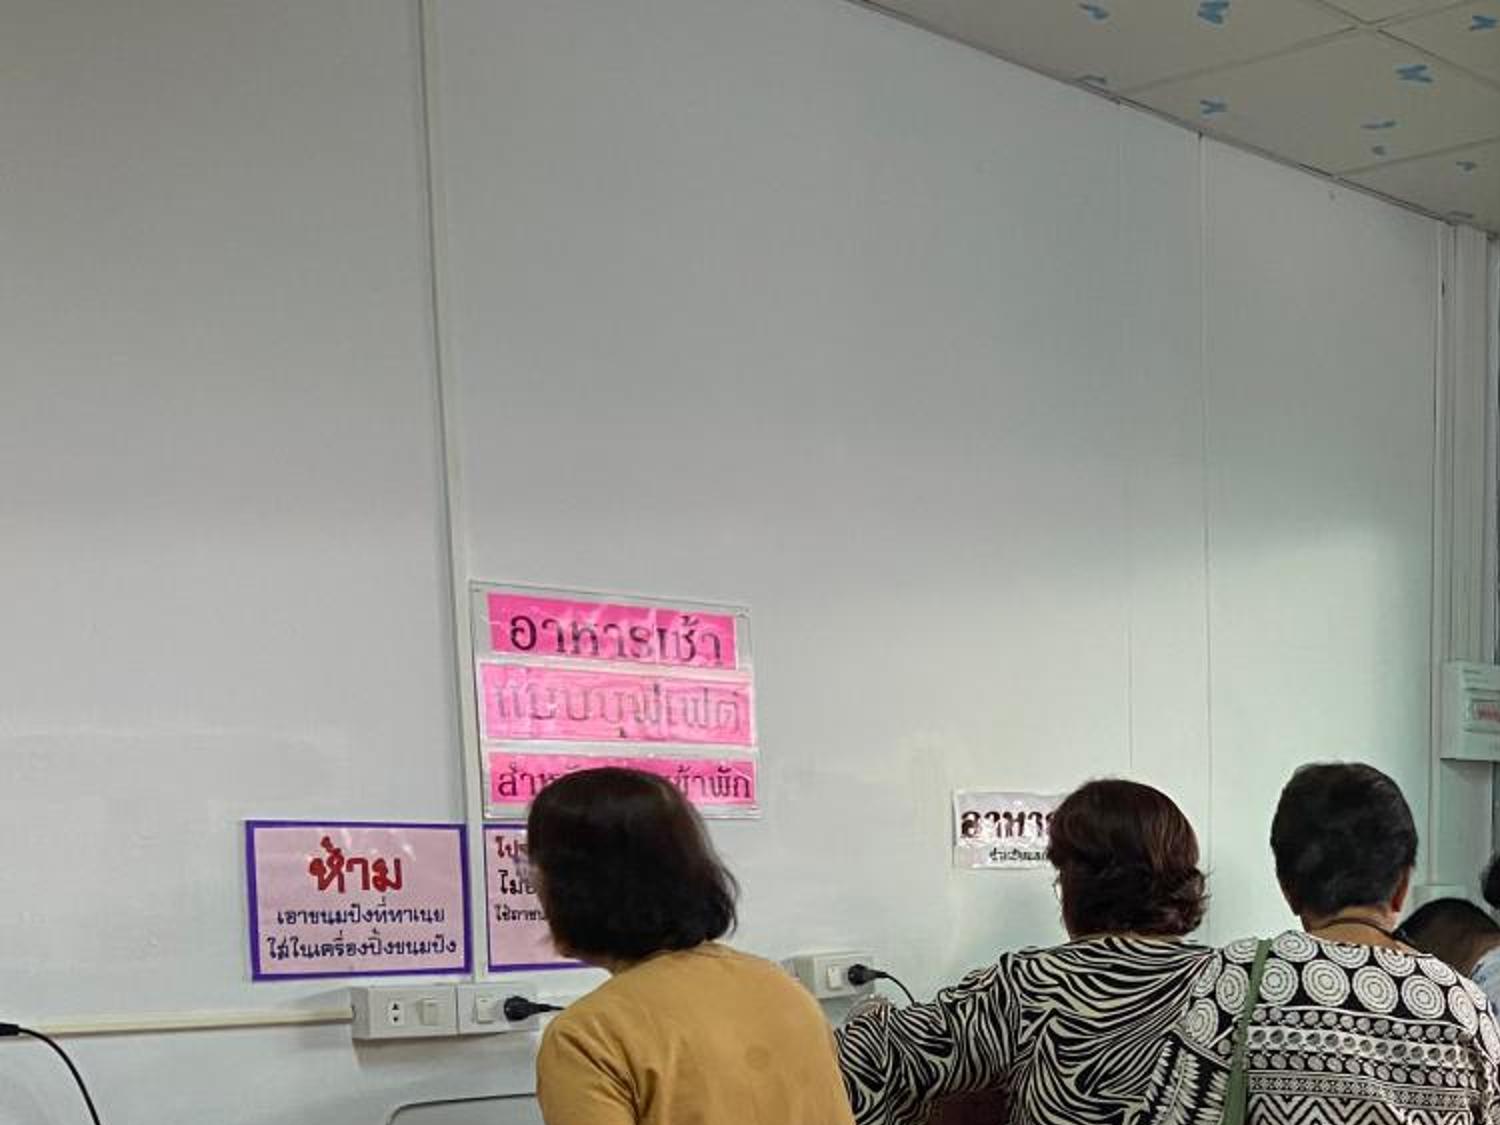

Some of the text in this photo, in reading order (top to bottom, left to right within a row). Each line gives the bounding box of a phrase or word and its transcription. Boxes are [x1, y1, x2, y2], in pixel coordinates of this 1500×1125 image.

[510, 614, 725, 667] อาหารเช้า
[309, 836, 402, 893] ห้าม
